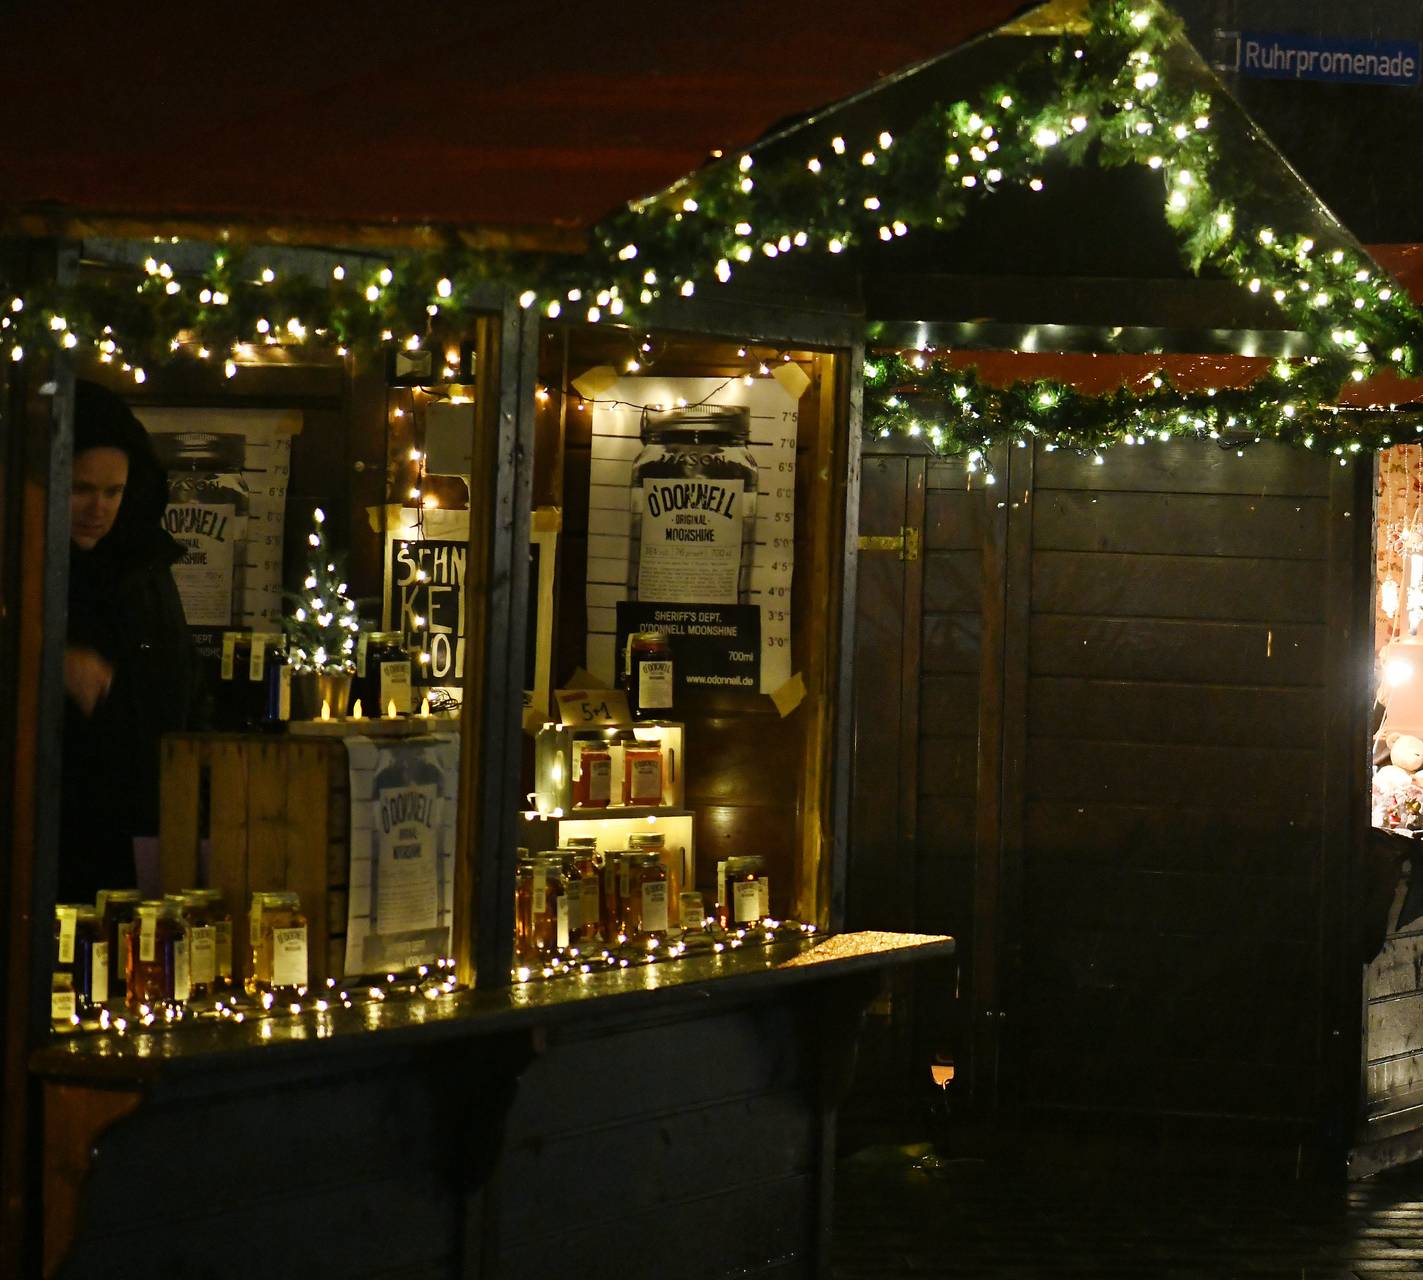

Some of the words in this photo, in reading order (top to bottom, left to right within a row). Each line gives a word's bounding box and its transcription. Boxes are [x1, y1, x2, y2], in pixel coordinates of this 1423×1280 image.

[1246, 42, 1415, 77] Ruhrpromenade
[648, 484, 736, 520] O'DONNELL
[665, 527, 715, 542] MOONSHINE
[654, 611, 697, 622] SHERIFF'S
[699, 612, 722, 623] DEPT.
[640, 623, 685, 635] O'DONNELL
[687, 625, 737, 637] MOONSHINE
[728, 651, 754, 662] 700ml
[686, 675, 754, 686] www.odonnell.de
[581, 702, 612, 721] 5+1
